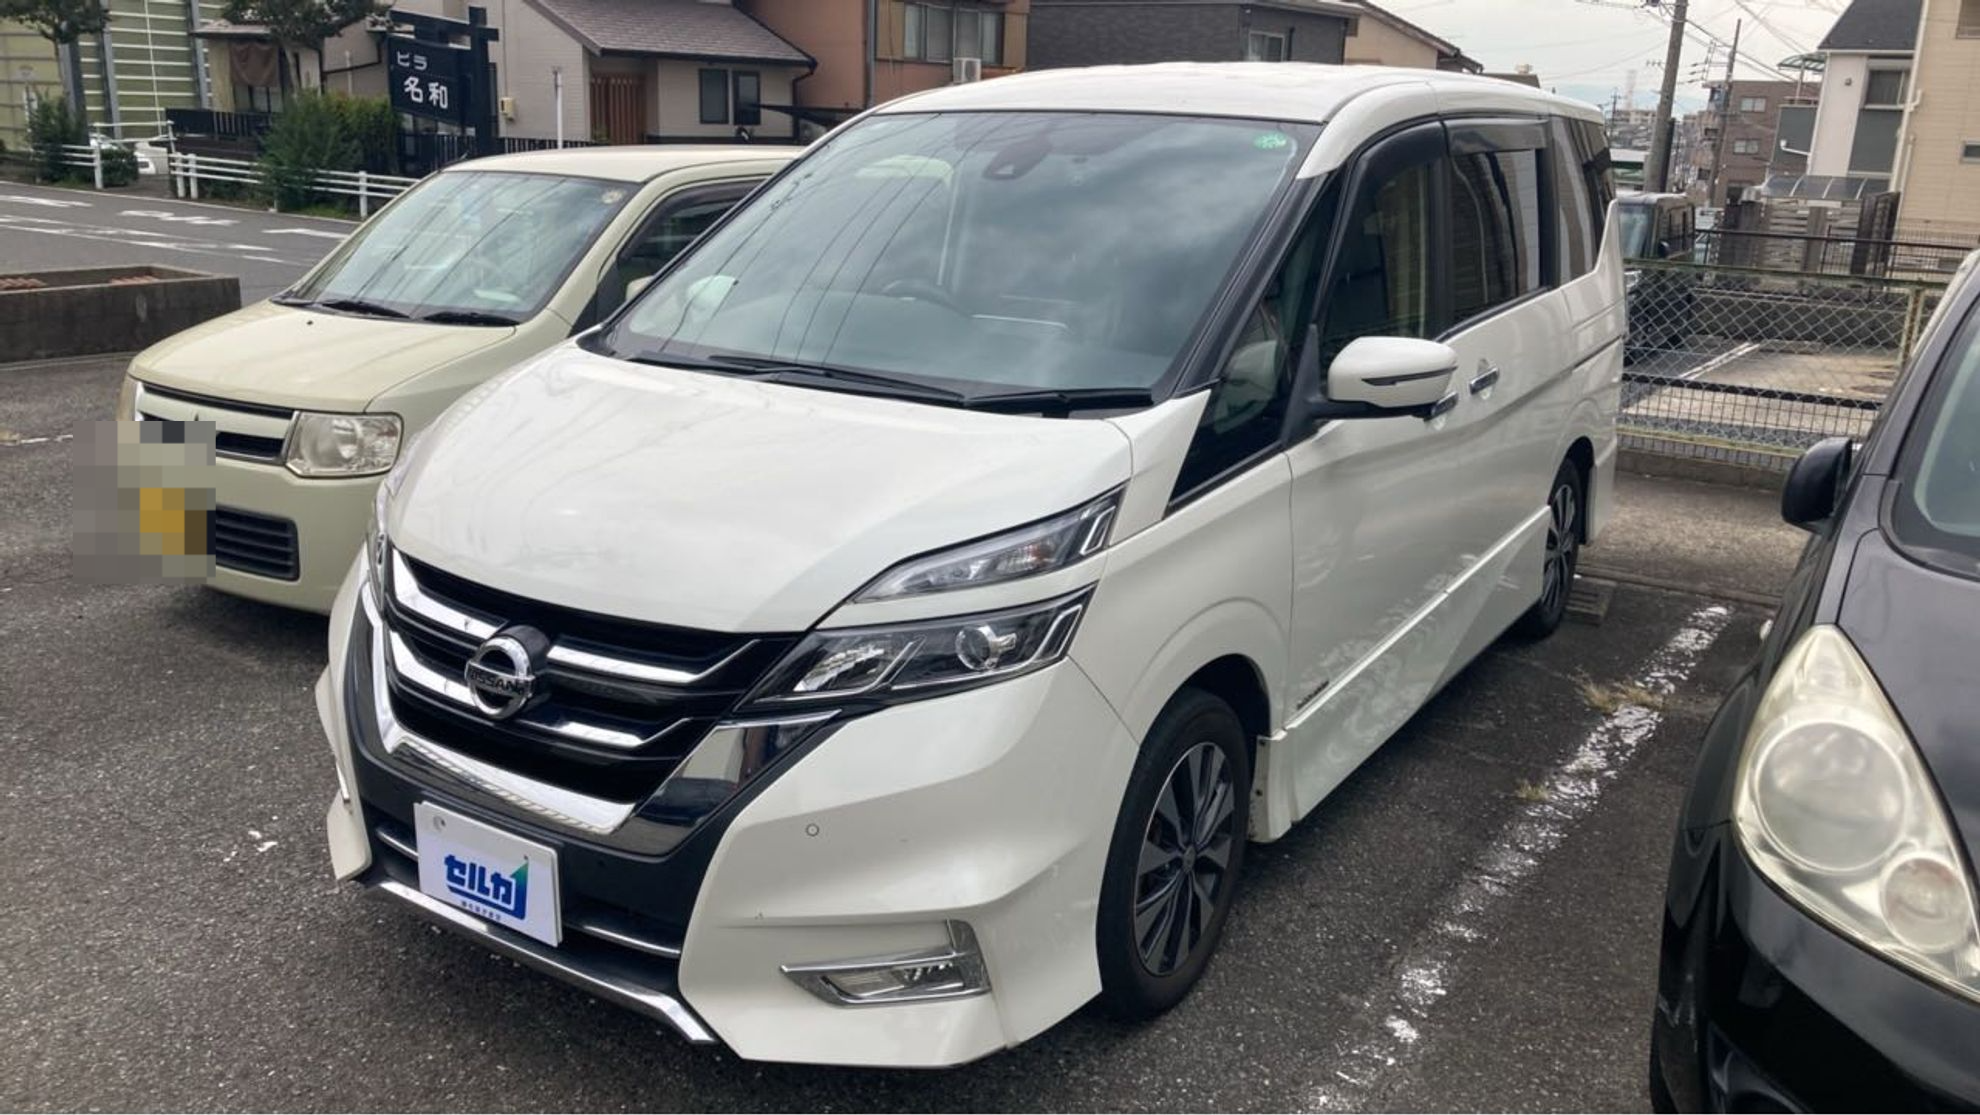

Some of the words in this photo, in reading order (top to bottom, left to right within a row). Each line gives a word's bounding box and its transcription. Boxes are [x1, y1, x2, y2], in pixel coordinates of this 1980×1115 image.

[403, 76, 448, 109] 名和
[444, 854, 514, 906] セルカ
